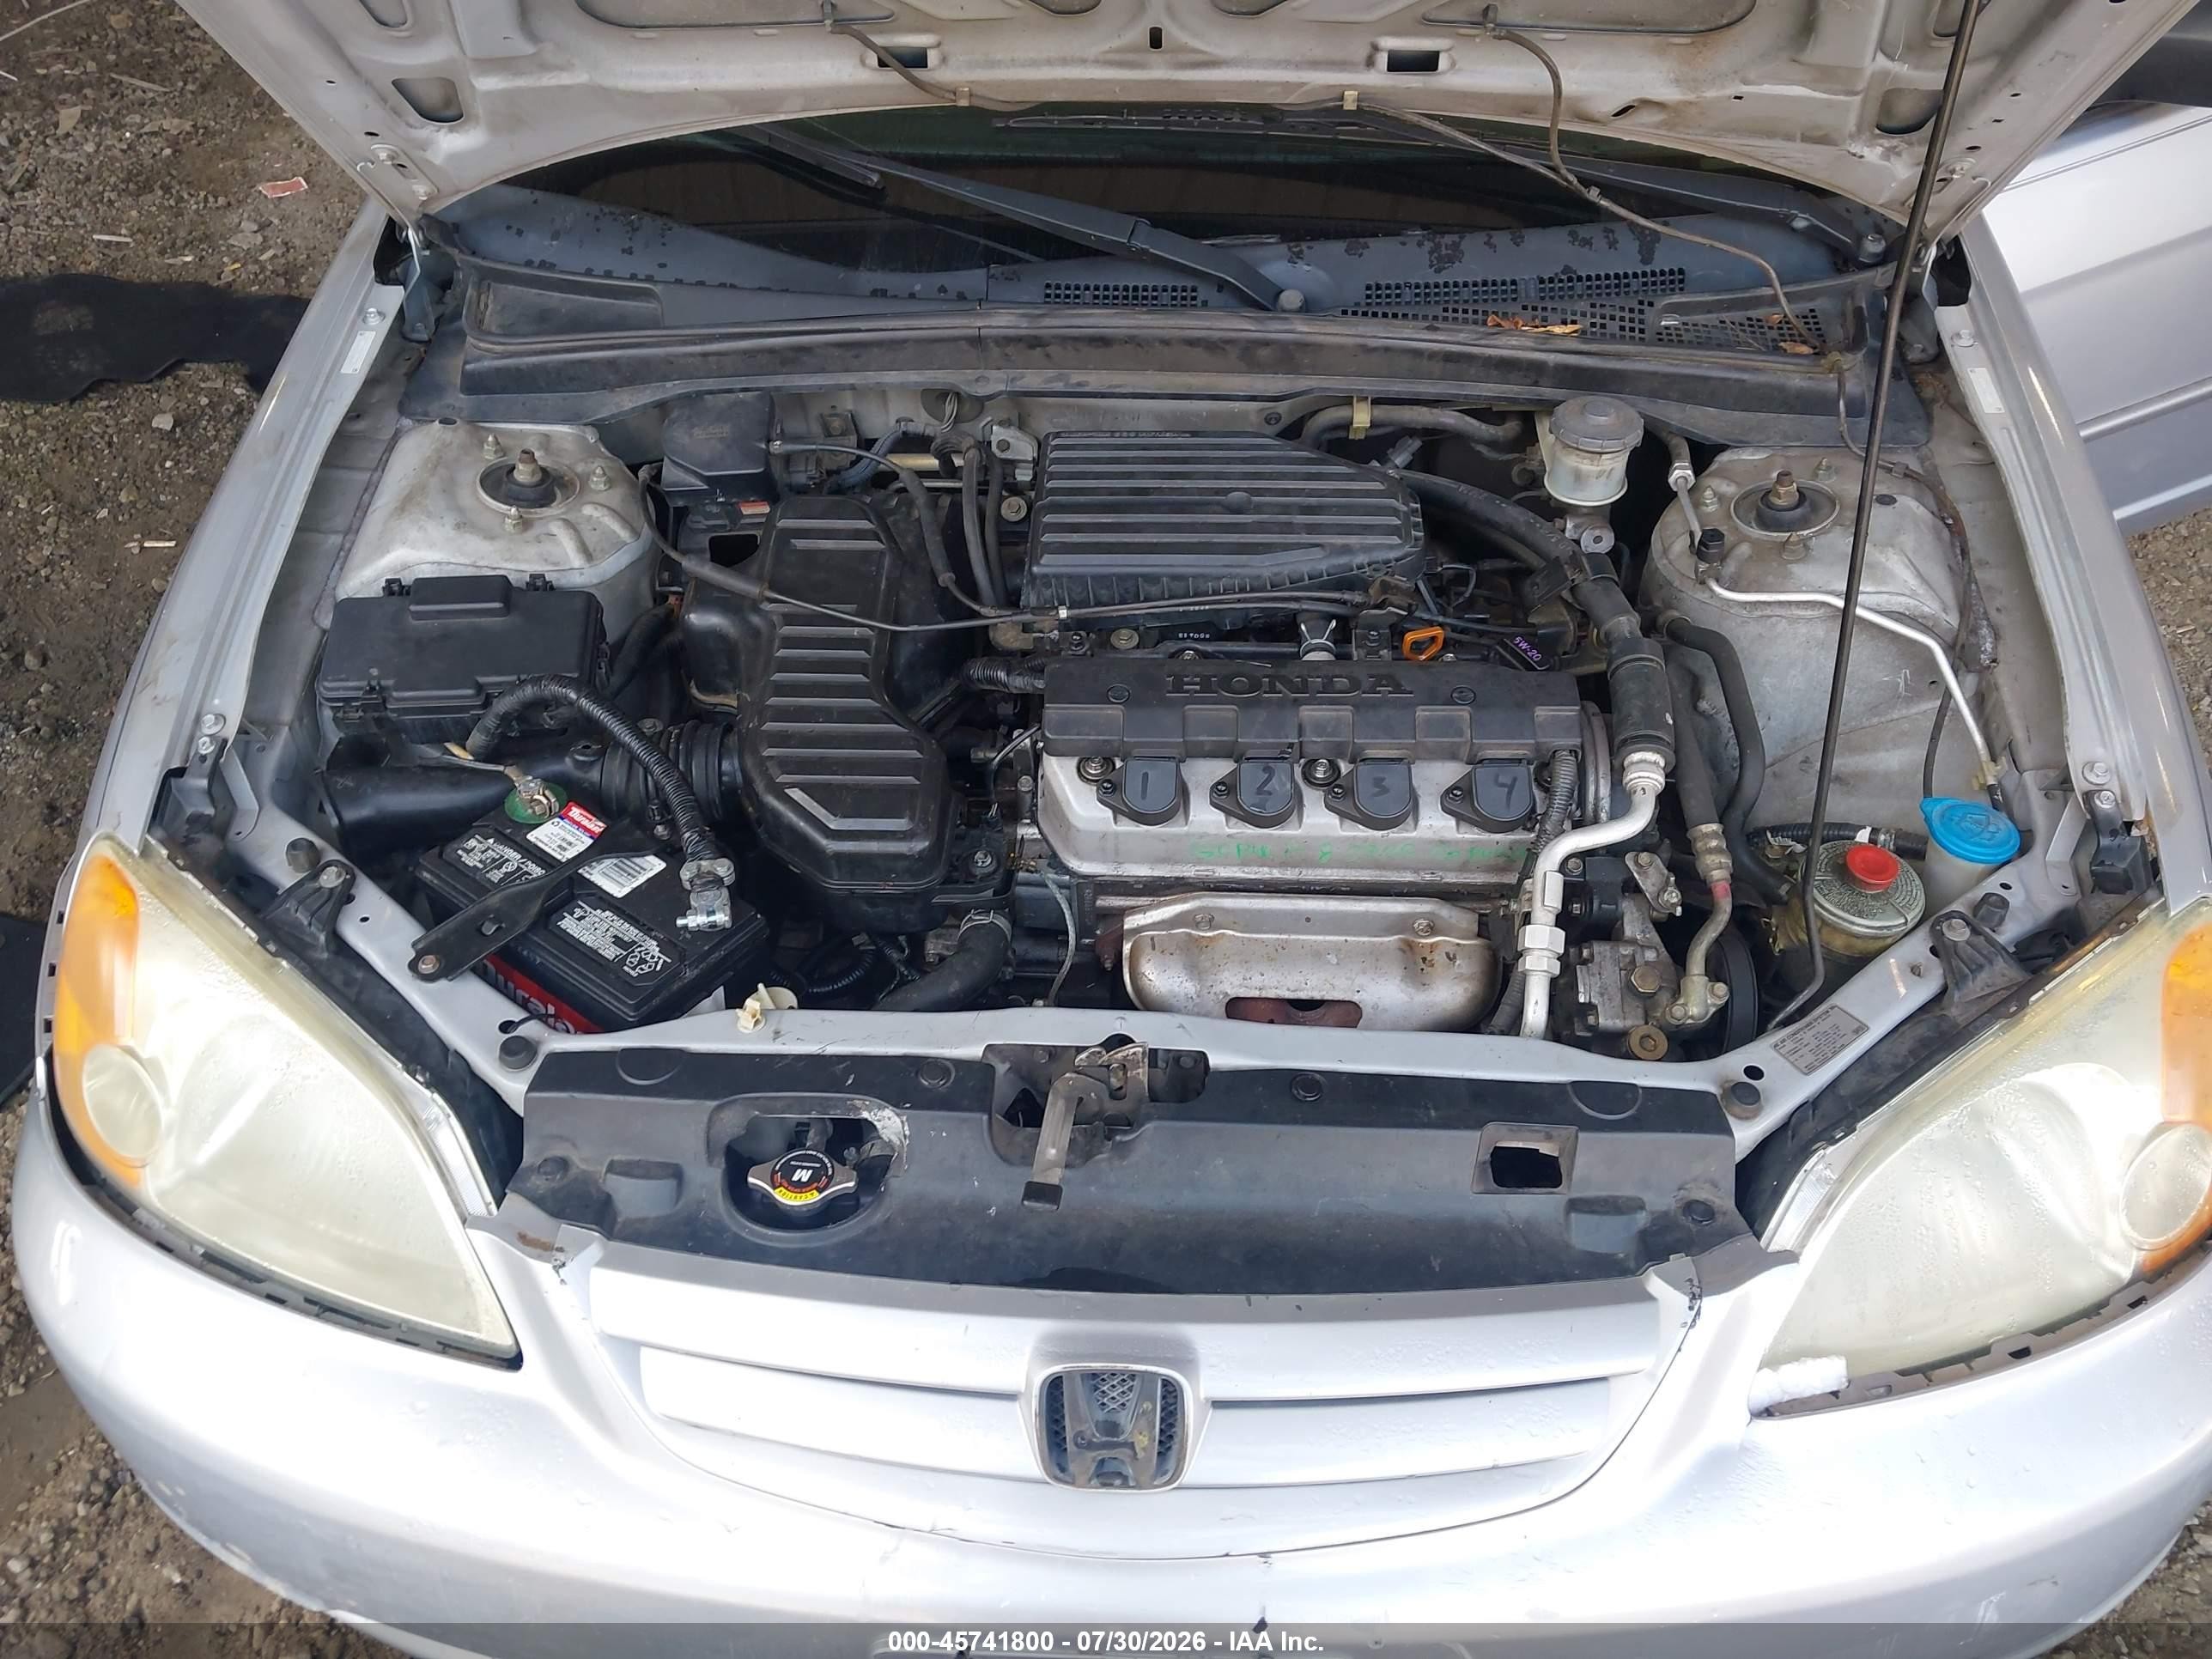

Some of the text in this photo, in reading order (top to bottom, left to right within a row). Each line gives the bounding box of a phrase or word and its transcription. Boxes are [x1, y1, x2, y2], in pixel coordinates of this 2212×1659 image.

[1513, 636, 1542, 661] 5W-20
[1164, 672, 1415, 697] HONDA
[1256, 765, 1276, 797] 2
[1370, 775, 1391, 798] 3
[1493, 774, 1518, 808] 4
